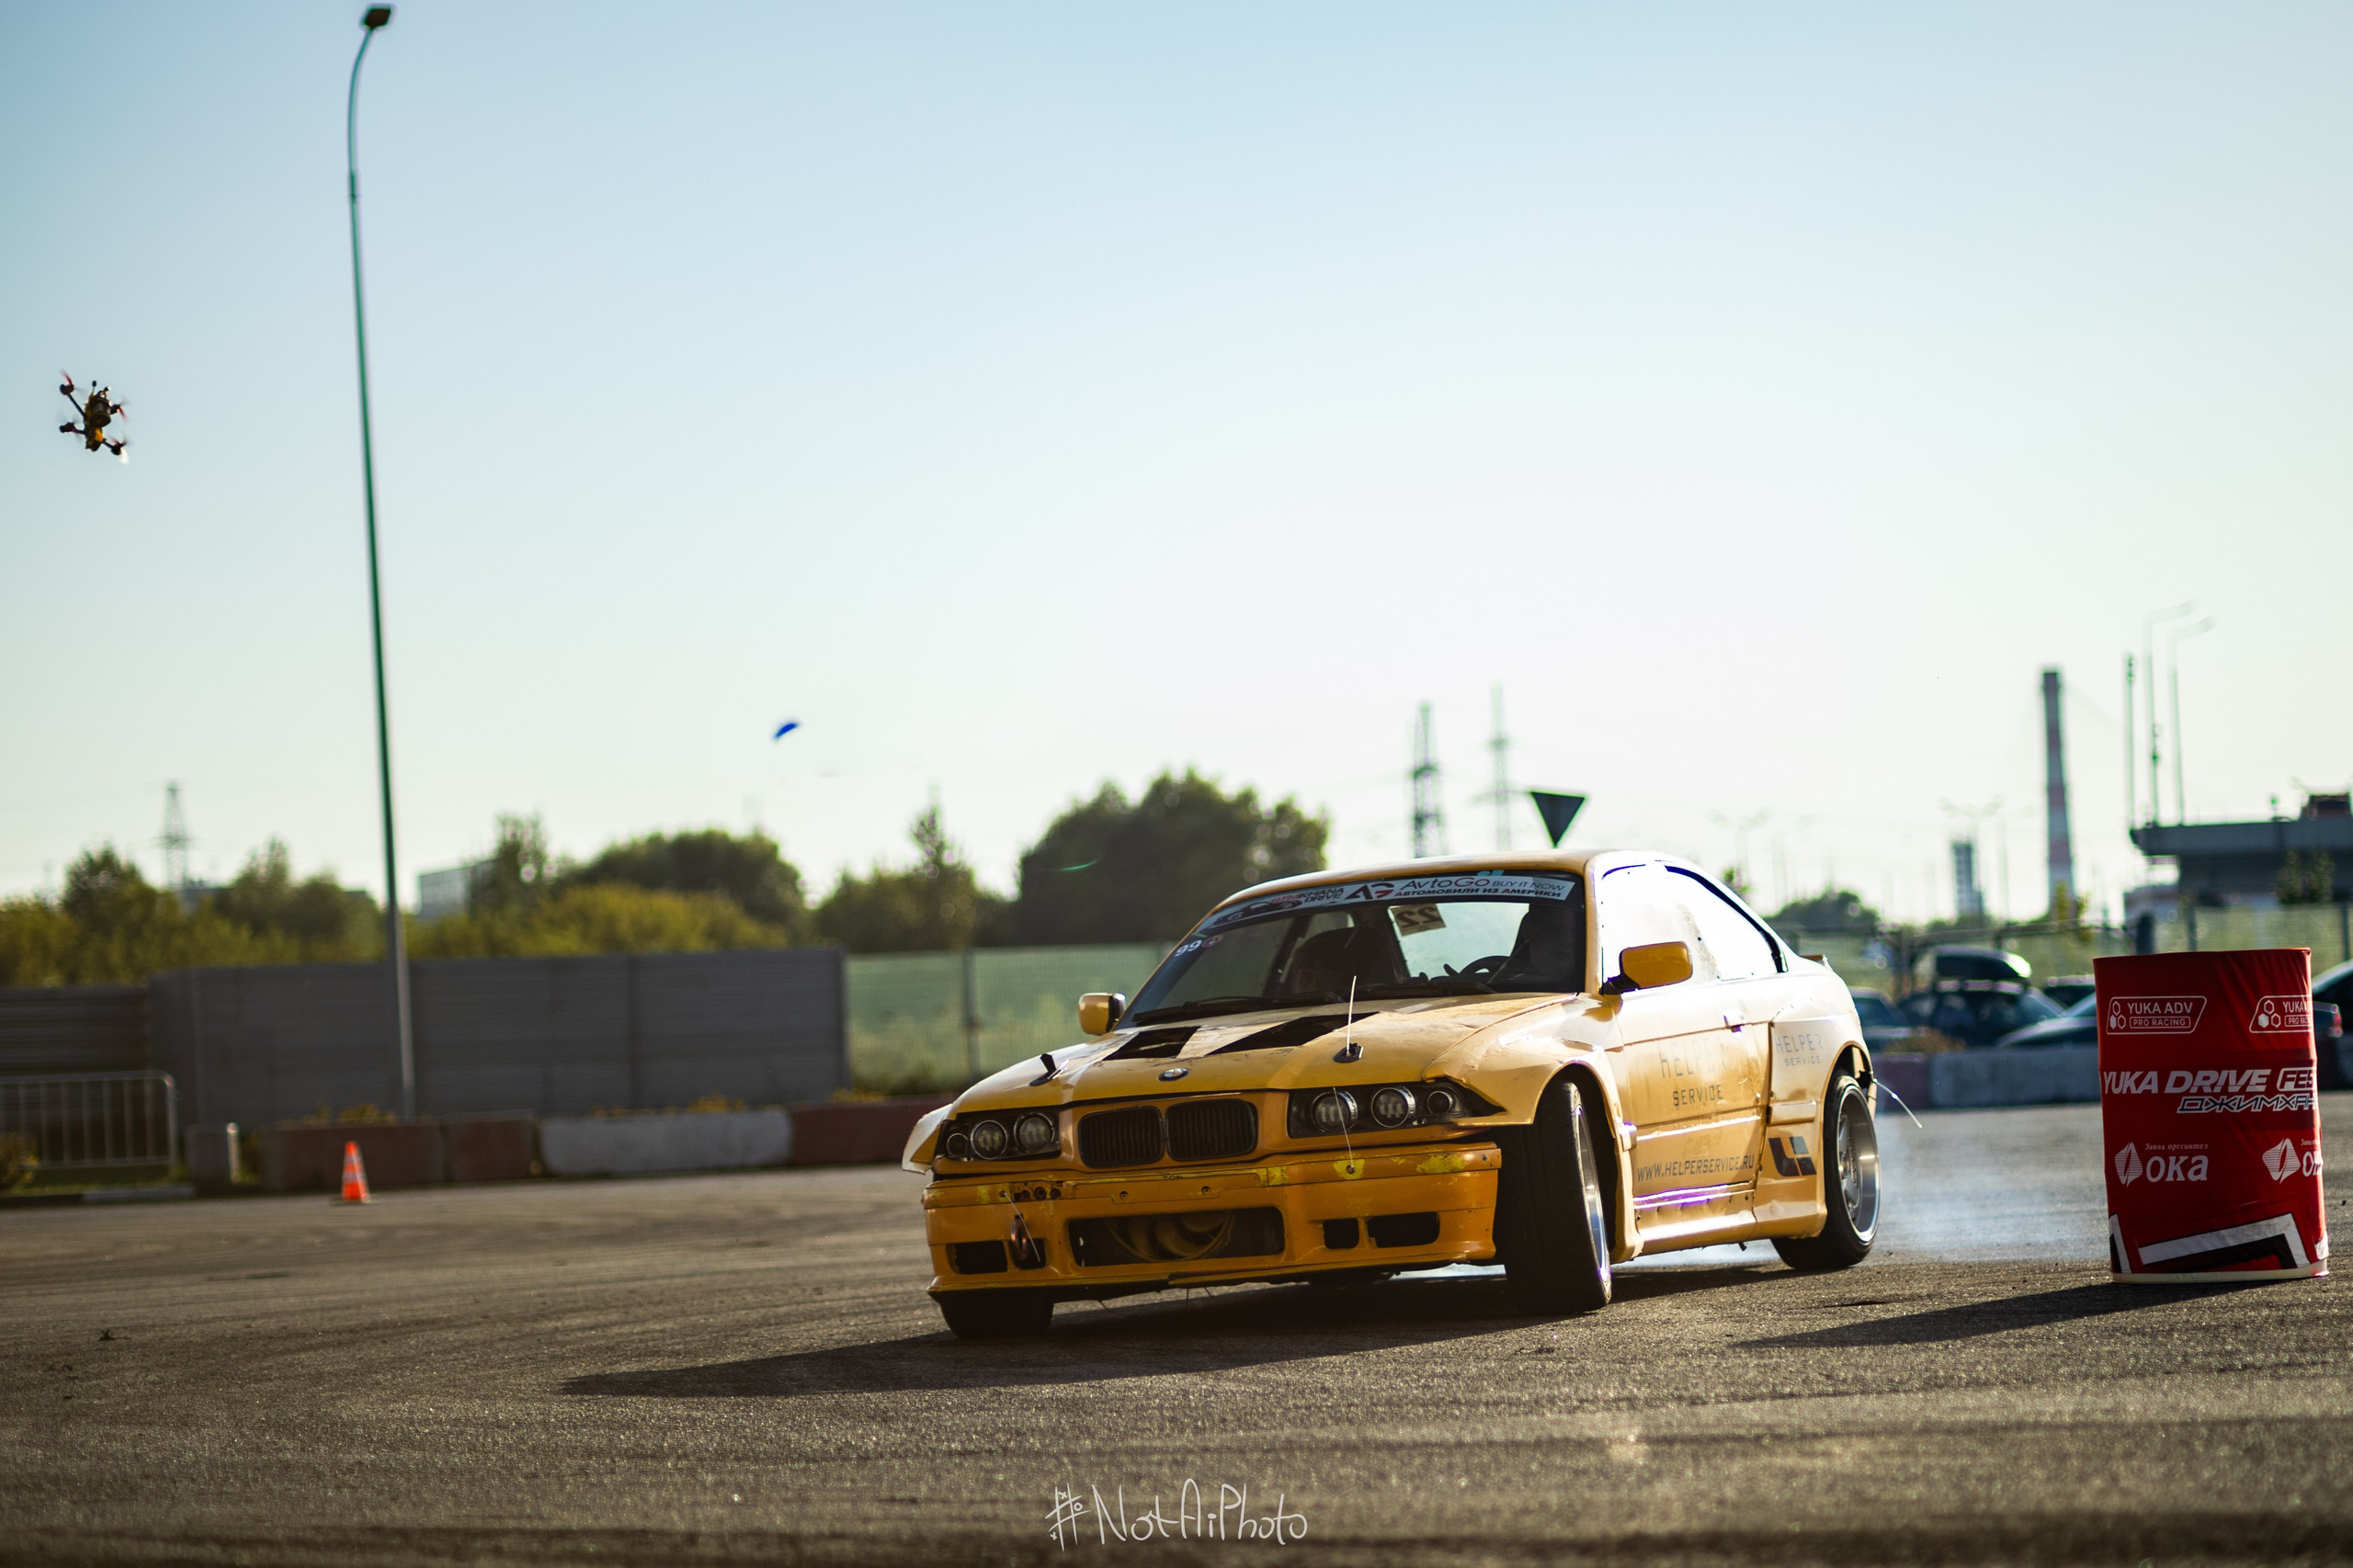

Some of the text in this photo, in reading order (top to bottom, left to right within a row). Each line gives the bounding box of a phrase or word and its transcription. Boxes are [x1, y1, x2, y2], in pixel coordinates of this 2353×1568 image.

[1401, 877, 1490, 890] AvtoGo
[1530, 882, 1565, 892] NOW
[1304, 893, 1342, 903] DRIVE
[1394, 888, 1480, 897] АВТОМОБИЛИ
[1502, 888, 1562, 898] АМЕРИКИ
[1175, 939, 1202, 957] 99
[2127, 1002, 2193, 1015] YUKA ADV
[2152, 1018, 2186, 1027] RACING
[1775, 1033, 1824, 1054] HELPER
[1784, 1055, 1822, 1067] SERVICE
[2104, 1071, 2158, 1094] YUKA
[2164, 1069, 2271, 1094] DRIVE
[1672, 1085, 1723, 1107] SERVICE
[1637, 1154, 1755, 1182] WWW.HELPERSERVICE.RU
